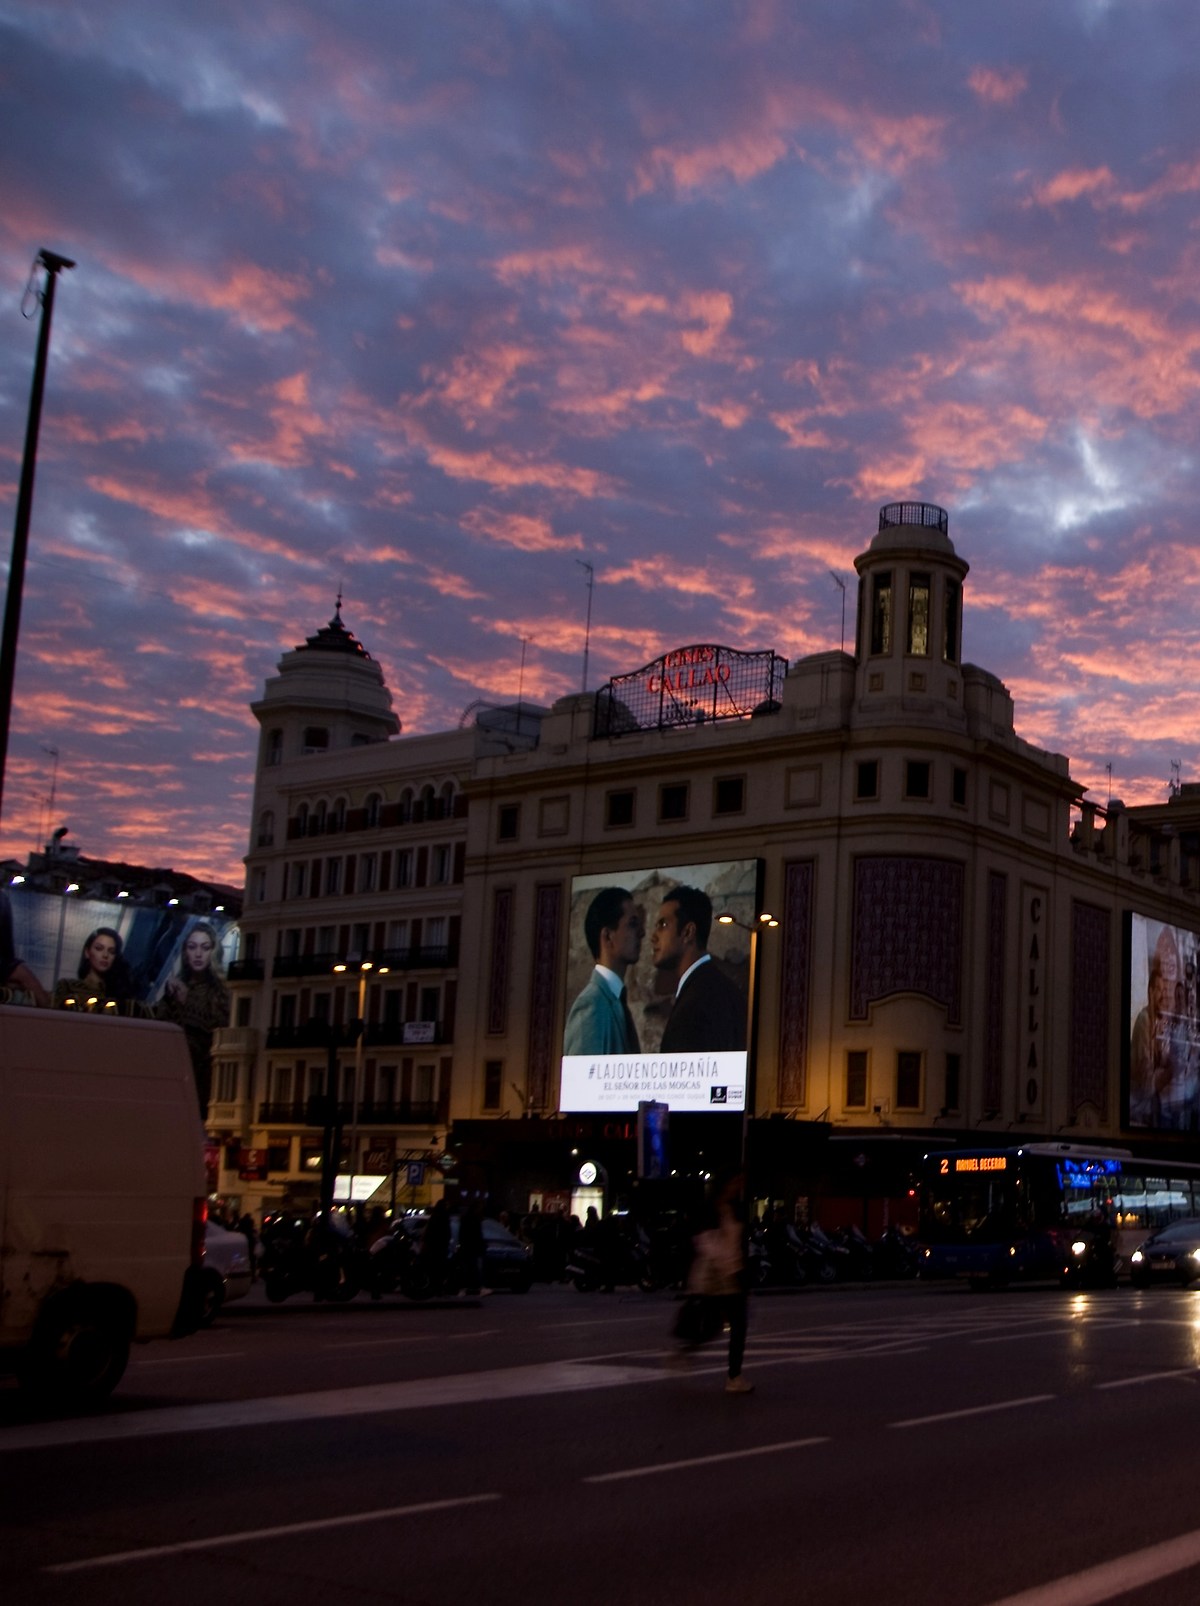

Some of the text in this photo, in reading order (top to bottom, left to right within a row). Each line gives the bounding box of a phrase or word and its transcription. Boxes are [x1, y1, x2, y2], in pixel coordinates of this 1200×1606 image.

[647, 664, 730, 693] CALLAO
[1027, 898, 1041, 1105] CALLAO
[588, 1056, 719, 1080] #LAJOVENCOMPAÑÍA
[604, 1079, 701, 1091] EL SEÑOR DE LAS MOSCAS
[409, 1165, 420, 1182] P
[940, 1159, 949, 1174] 2
